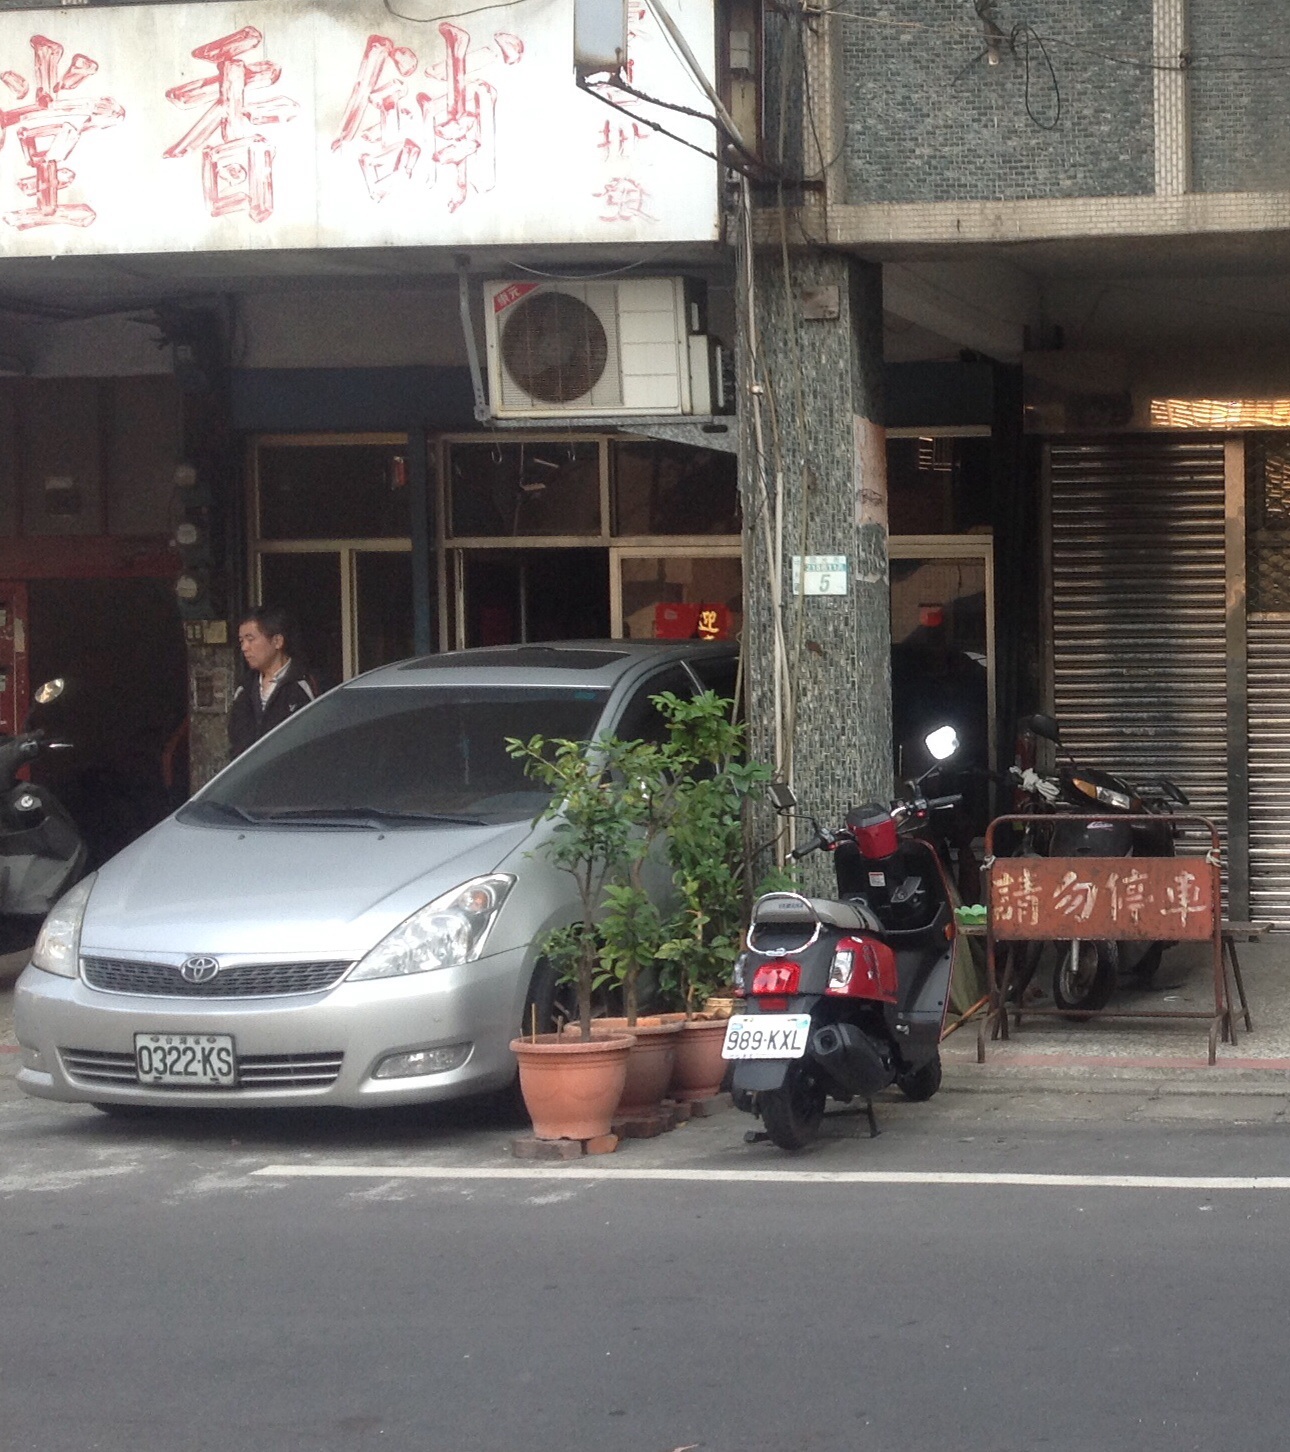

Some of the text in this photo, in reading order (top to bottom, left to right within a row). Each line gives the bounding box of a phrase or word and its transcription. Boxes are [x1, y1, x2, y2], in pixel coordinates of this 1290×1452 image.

[818, 573, 831, 593] 5
[992, 868, 1207, 928] 請勿停車
